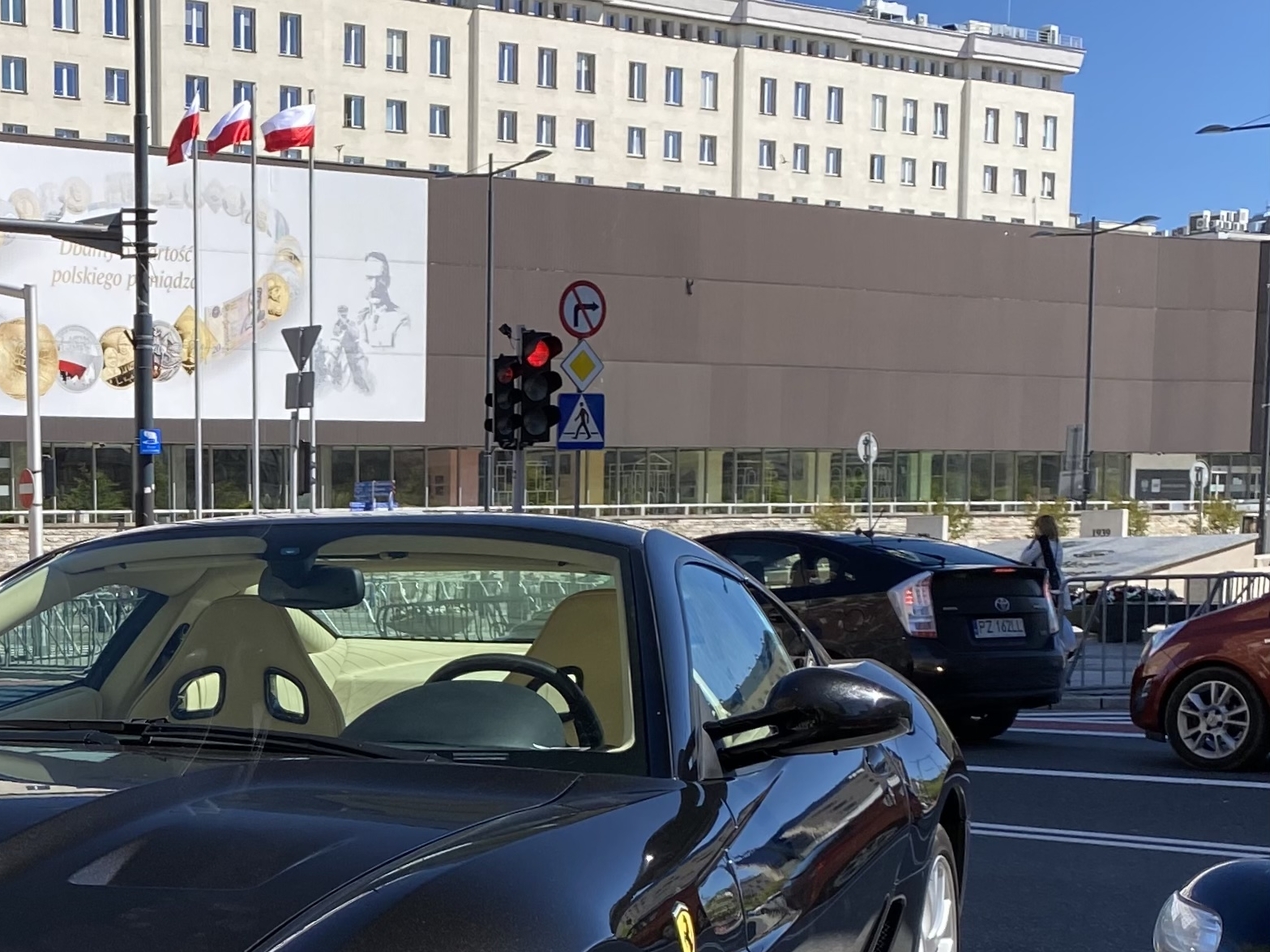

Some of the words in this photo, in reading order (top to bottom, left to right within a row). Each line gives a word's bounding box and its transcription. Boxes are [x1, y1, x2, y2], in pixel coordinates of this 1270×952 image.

[51, 266, 122, 290] polskiego
[126, 271, 196, 293] pniądza
[1092, 529, 1111, 537] 1939
[979, 620, 994, 634] PZ
